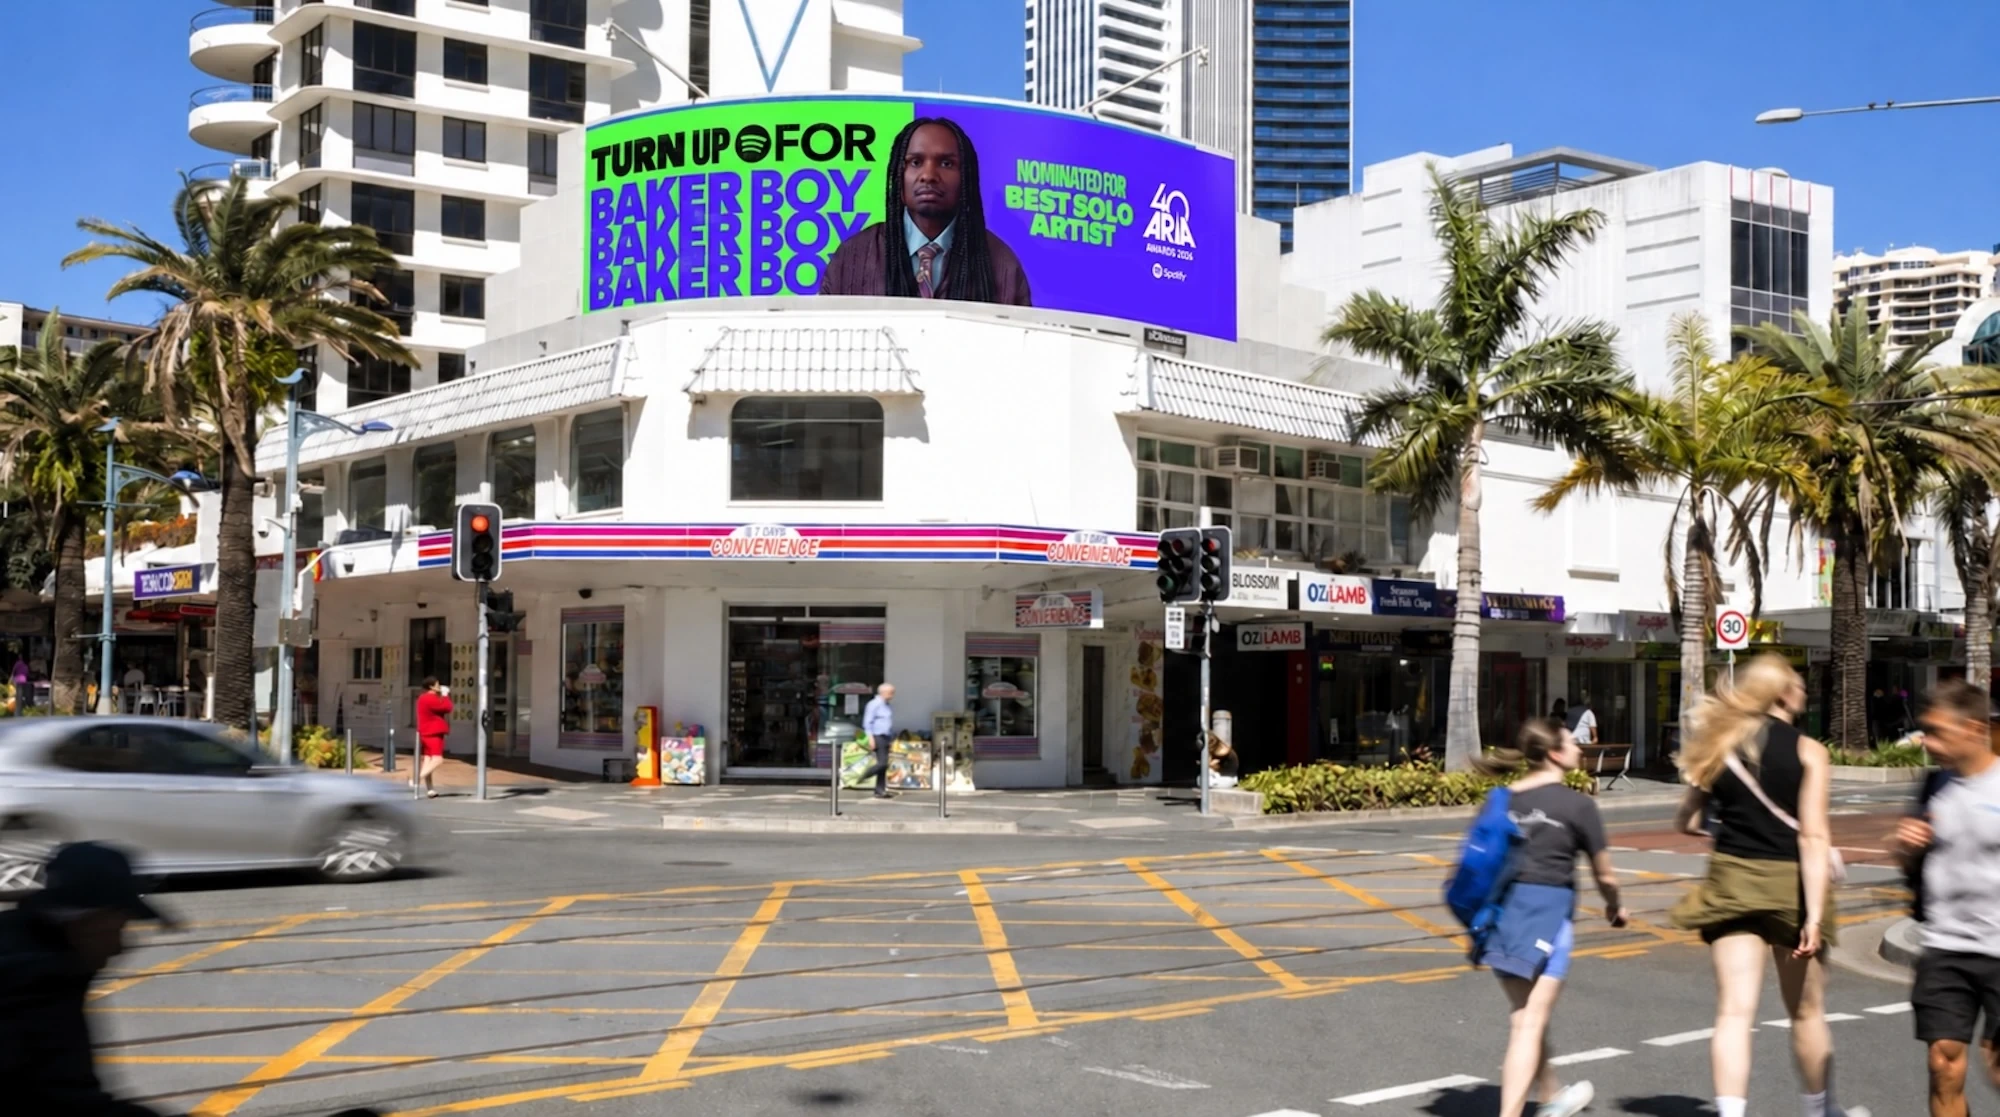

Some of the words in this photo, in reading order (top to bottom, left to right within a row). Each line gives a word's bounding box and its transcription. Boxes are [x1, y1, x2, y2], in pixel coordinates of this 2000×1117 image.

[591, 131, 685, 182] TURN
[692, 127, 731, 167] UP
[775, 123, 876, 162] FOR
[591, 171, 743, 229] BAKER
[751, 168, 871, 212] BOY
[1017, 158, 1103, 194] NOMINATED
[1103, 171, 1127, 200] FOR
[1004, 184, 1072, 216] BEST
[1073, 193, 1134, 227] SOLO
[1149, 182, 1190, 222] 40
[590, 212, 743, 270] BAKER
[1029, 212, 1117, 248] ARTIST
[1142, 210, 1197, 249] ARIA
[1145, 242, 1176, 258] AWARDS
[589, 253, 743, 311] BAKER
[750, 252, 836, 297] BO
[1163, 267, 1187, 282] Spotify
[711, 538, 819, 556] CONVENIENCE
[1232, 573, 1279, 590] BLOSSOM
[1723, 619, 1742, 634] 30
